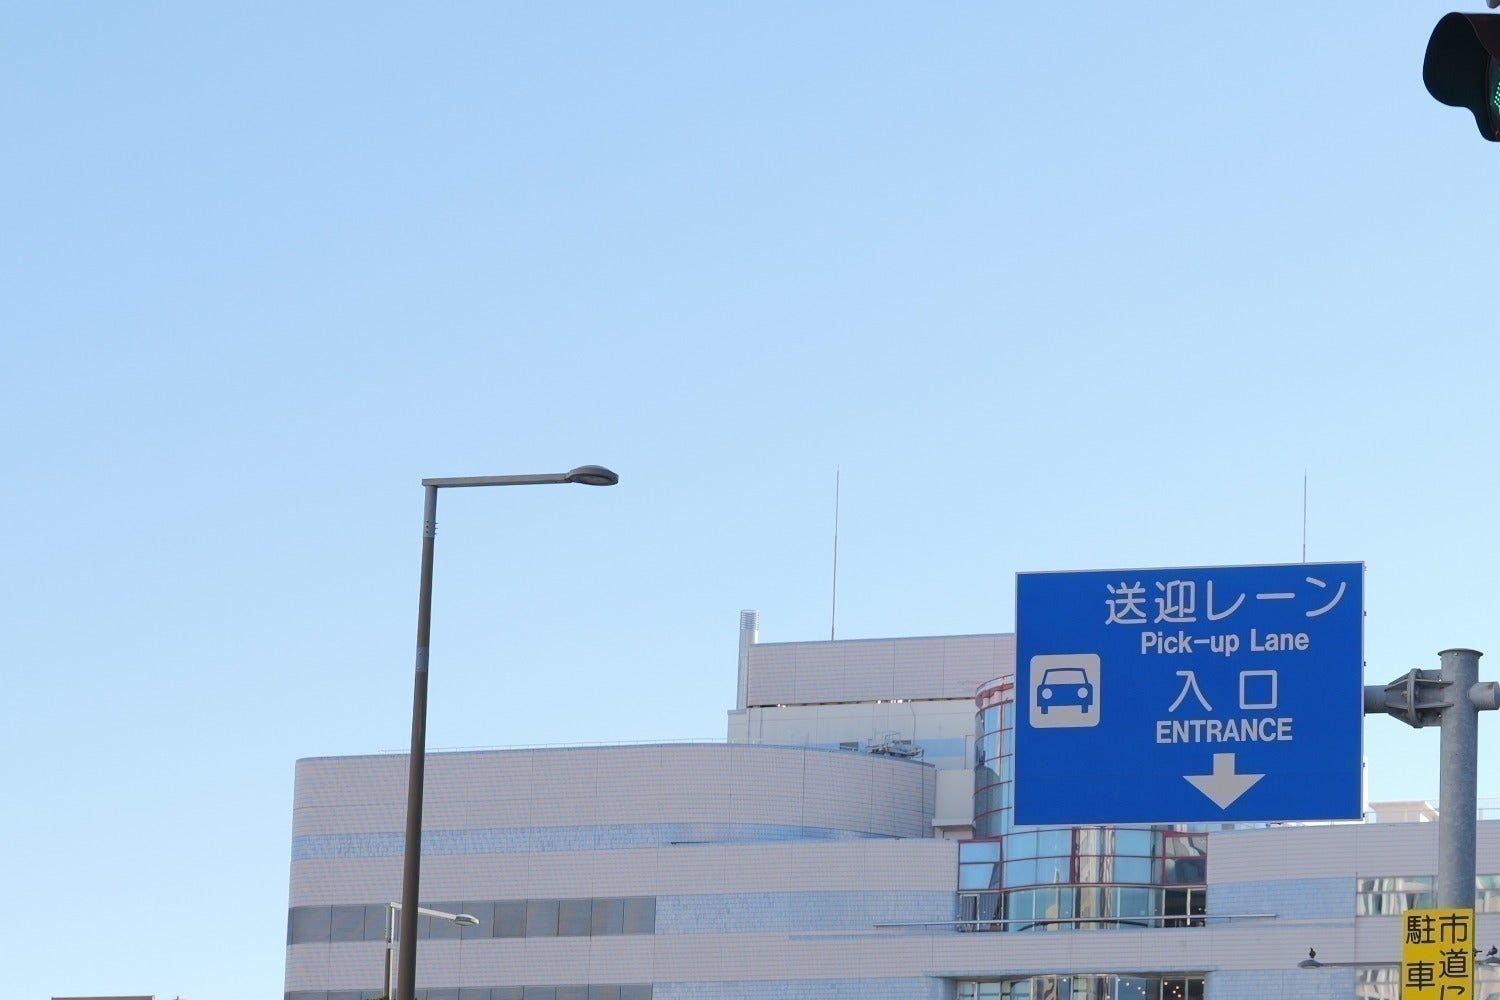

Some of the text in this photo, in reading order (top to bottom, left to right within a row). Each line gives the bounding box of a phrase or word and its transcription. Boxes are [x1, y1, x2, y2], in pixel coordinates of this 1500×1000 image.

[1105, 575, 1346, 626] 送迎レーン
[1141, 628, 1309, 656] Pick-up Lane
[1167, 669, 1278, 713] 入口
[1156, 716, 1293, 744] ENTRANCE
